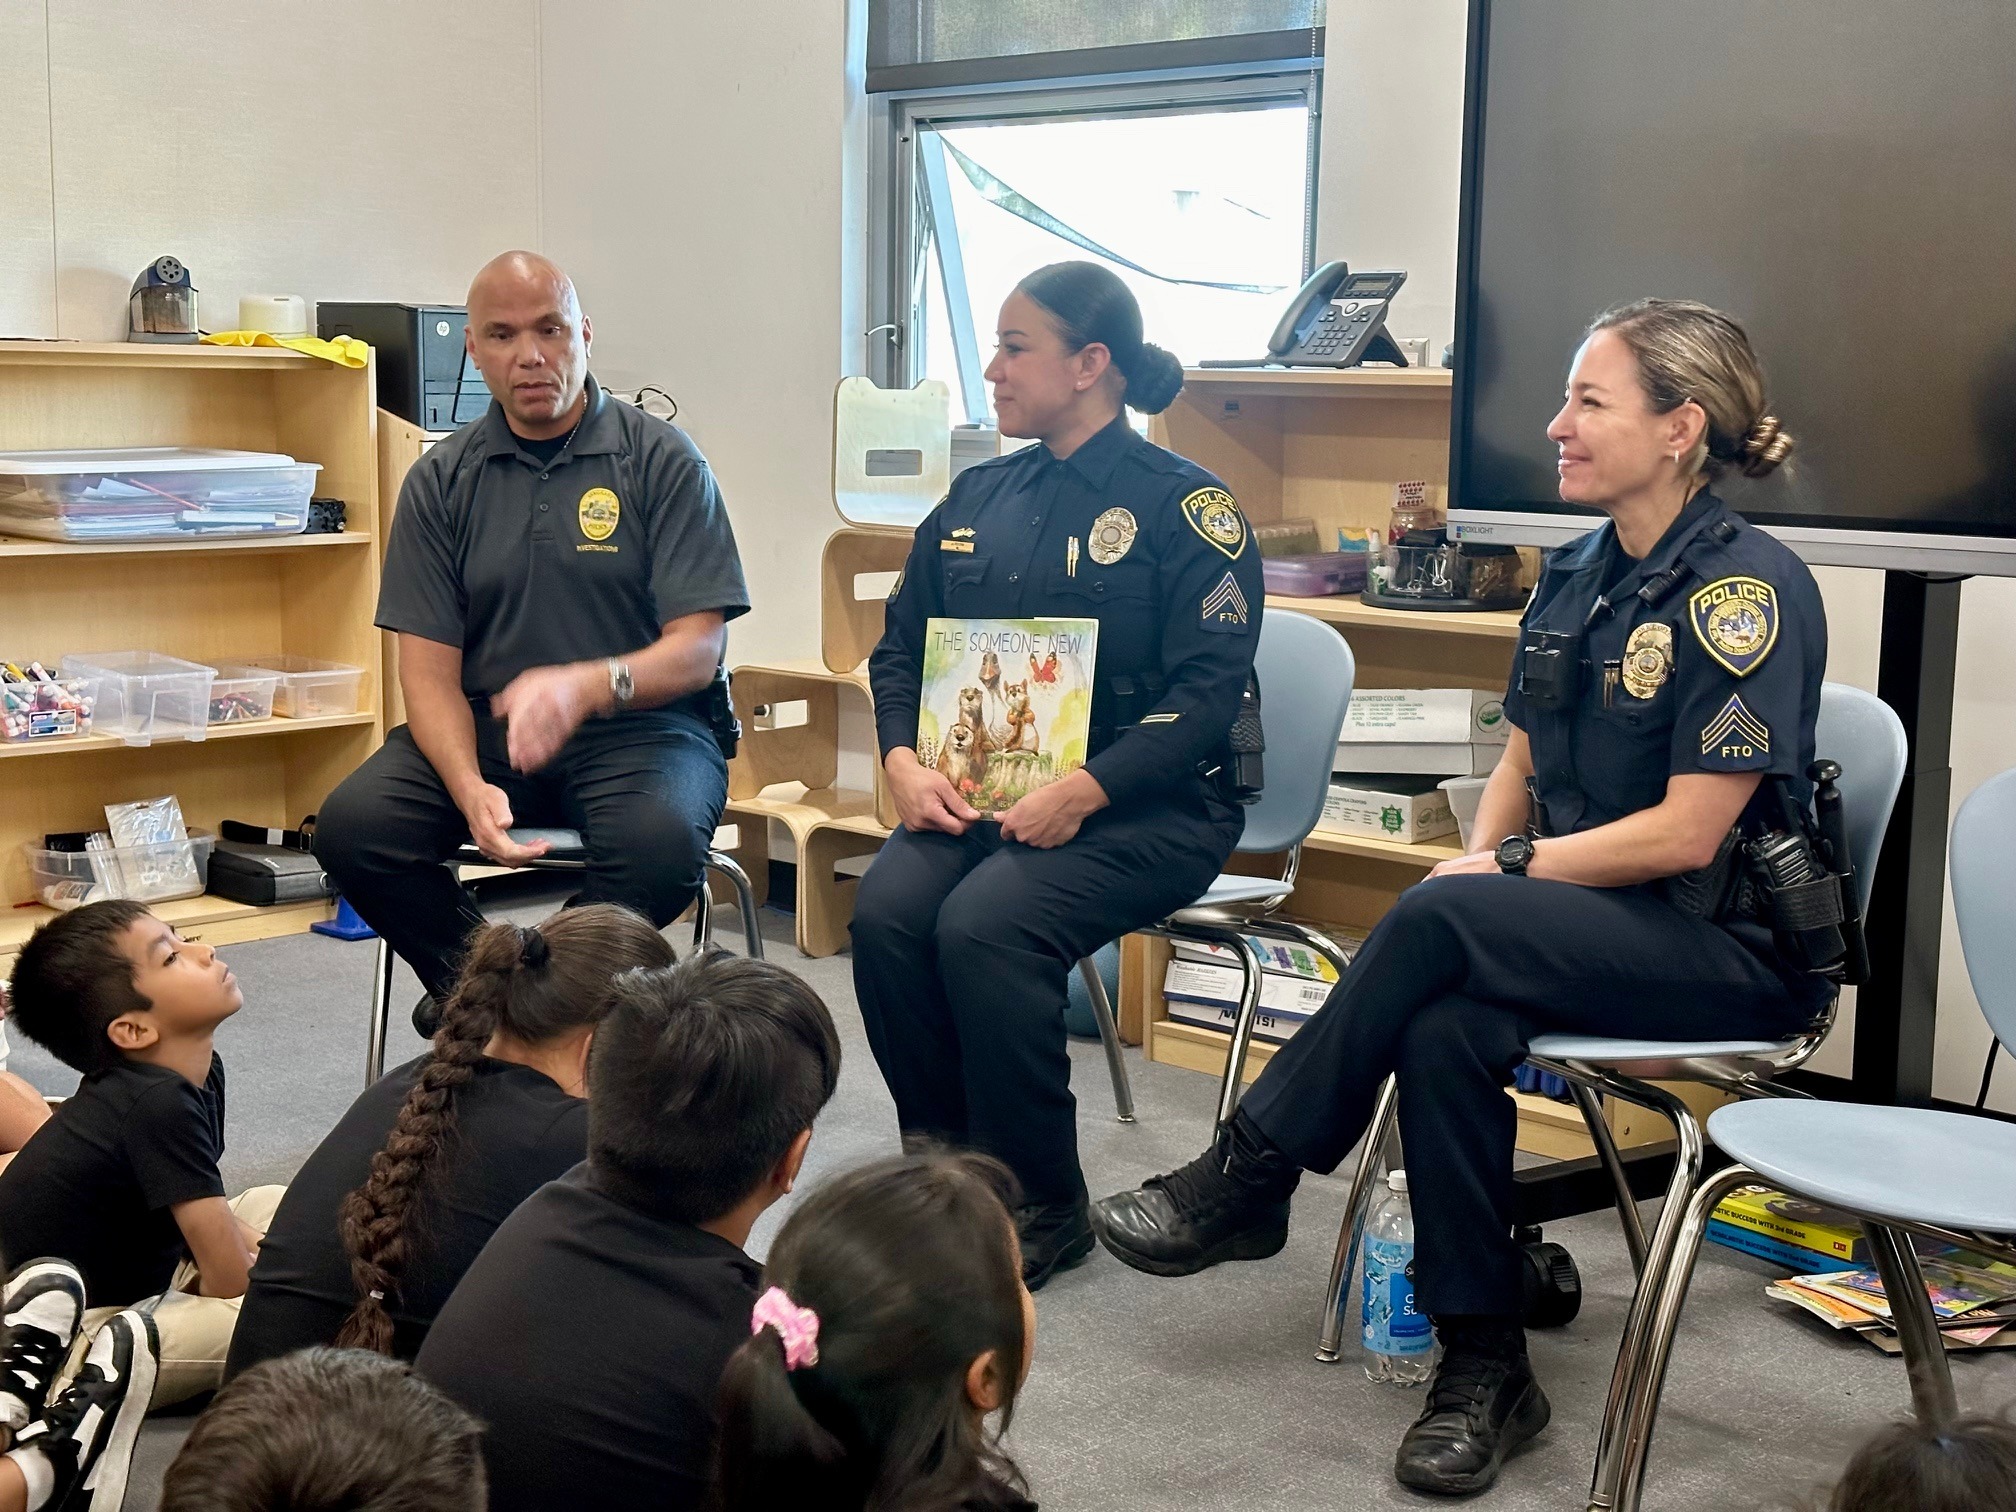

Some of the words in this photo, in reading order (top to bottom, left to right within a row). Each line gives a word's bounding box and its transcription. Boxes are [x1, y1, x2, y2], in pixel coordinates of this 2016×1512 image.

[1190, 492, 1237, 515] POLICE
[1461, 525, 1494, 535] BOXLIGHT
[1700, 583, 1770, 614] POLICE
[1220, 612, 1239, 624] FTO
[935, 632, 963, 651] THE
[969, 632, 1041, 654] SOMEONE
[1047, 633, 1083, 654] NEW
[1721, 745, 1753, 758] FTO
[1731, 1211, 1758, 1225] SUCCESS
[1758, 1218, 1775, 1230] WITH
[1785, 1227, 1806, 1239] GRADE
